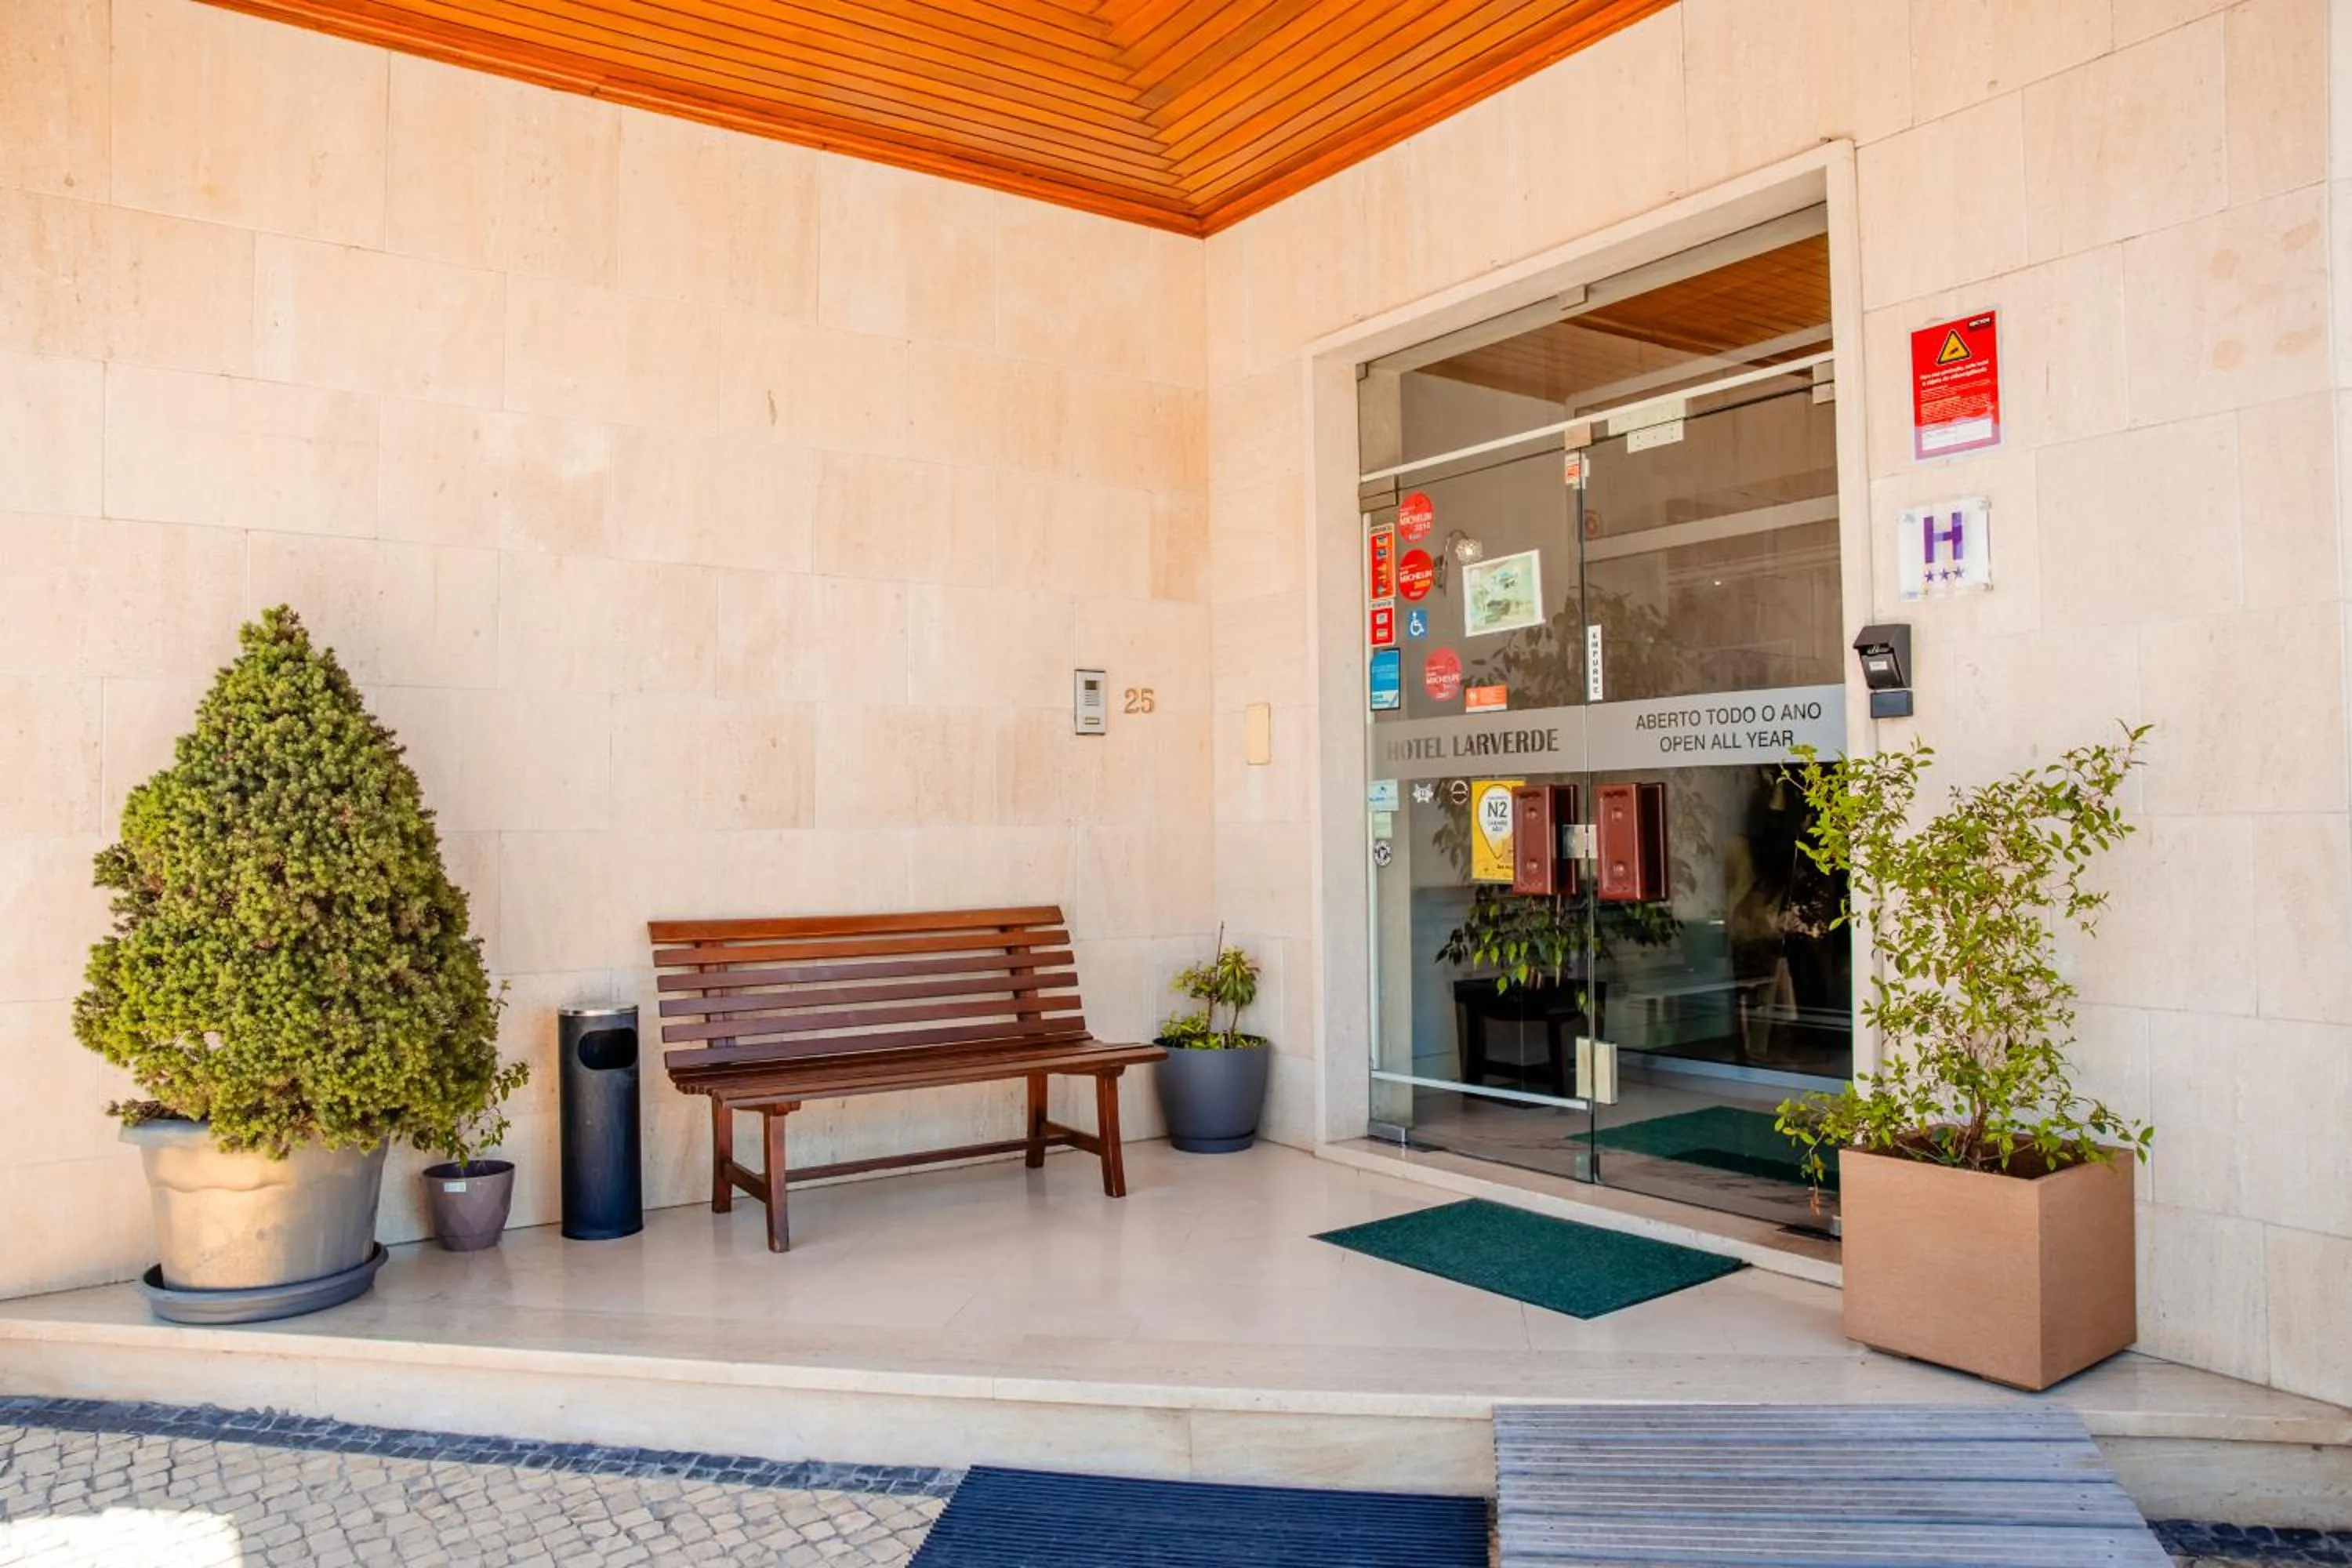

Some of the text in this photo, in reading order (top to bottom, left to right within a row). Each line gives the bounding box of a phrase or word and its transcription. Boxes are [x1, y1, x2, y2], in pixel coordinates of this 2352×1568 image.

[1923, 512, 1963, 564] H
[1399, 570, 1432, 583] MICHELIN
[1123, 688, 1156, 714] 25
[1635, 702, 1821, 730] ABERTO TODO O ANO
[1386, 728, 1560, 761] HOTEL LARVERDE
[1660, 730, 1794, 753] OPEN ALL YEAR
[1487, 801, 1508, 818] N2
